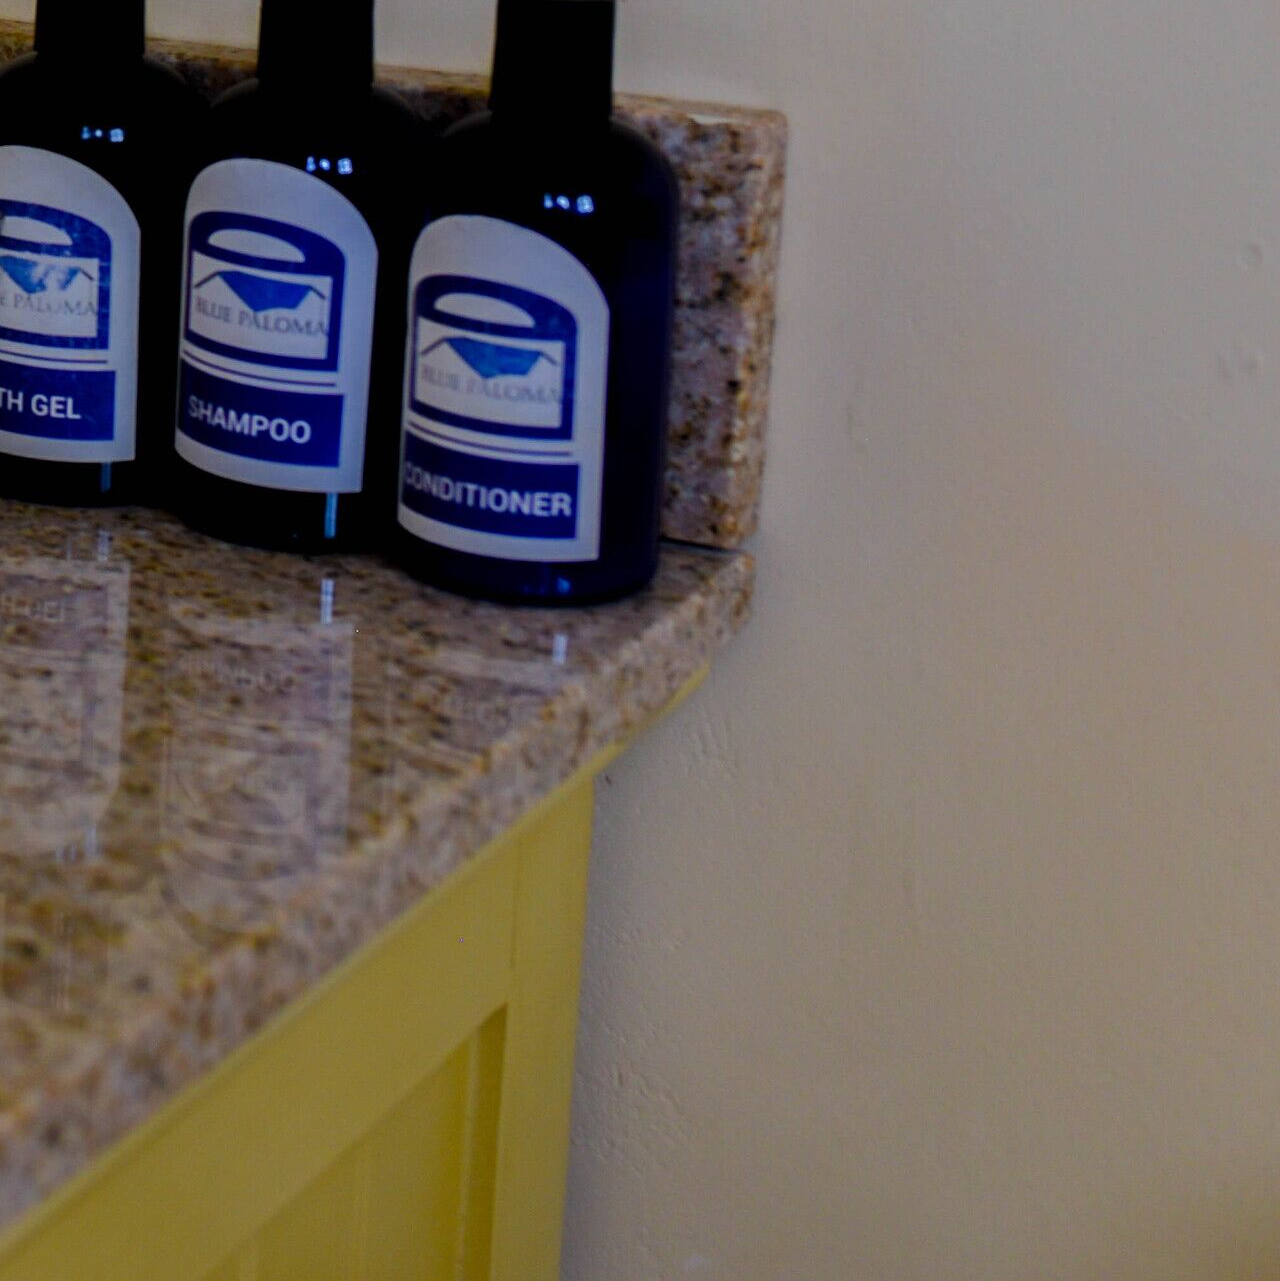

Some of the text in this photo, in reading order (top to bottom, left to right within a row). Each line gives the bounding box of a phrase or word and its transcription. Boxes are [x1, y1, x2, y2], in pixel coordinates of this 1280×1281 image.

[195, 295, 329, 337] BLUE PALOMA
[30, 394, 81, 420] GEL
[188, 398, 312, 444] SHAMPOO
[405, 461, 572, 517] CONDITIONER
